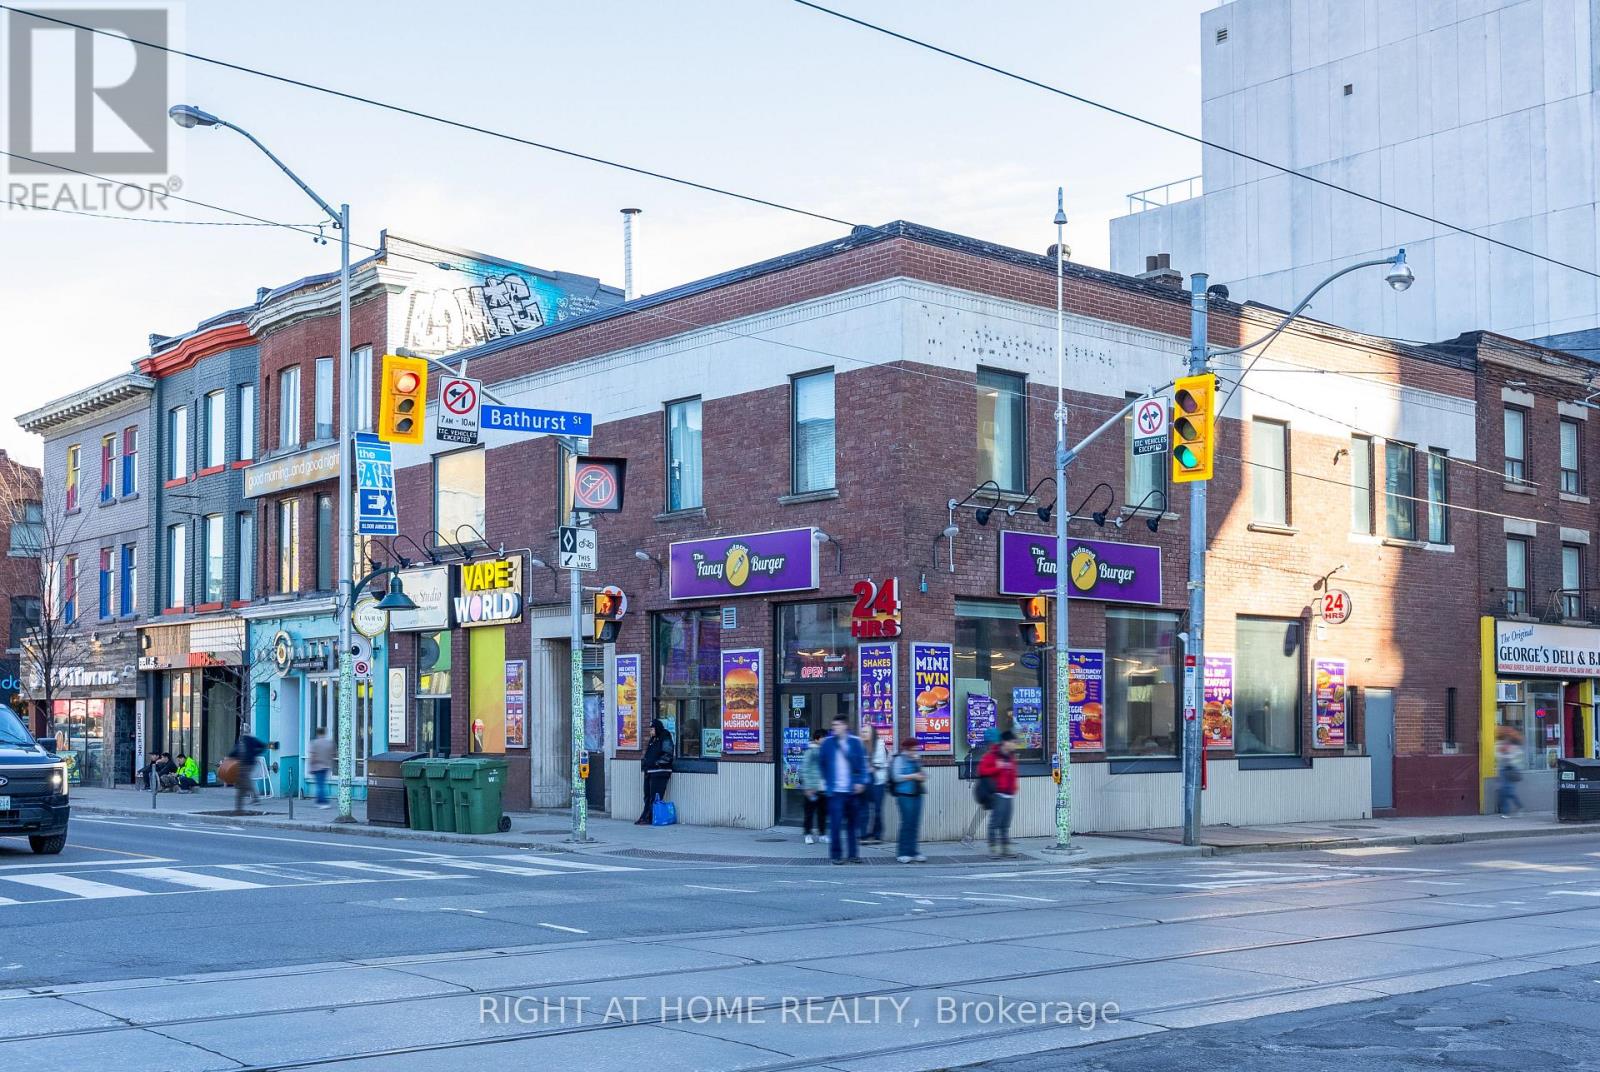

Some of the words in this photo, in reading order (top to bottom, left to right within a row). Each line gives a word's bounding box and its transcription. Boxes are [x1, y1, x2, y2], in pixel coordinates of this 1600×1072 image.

[441, 415, 454, 425] 7AM
[461, 418, 476, 427] 10AM
[491, 409, 566, 431] Bathurst
[573, 415, 582, 425] St
[443, 434, 470, 442] EXCEPTED
[450, 429, 477, 438] VEHICLES
[1144, 436, 1167, 446] VEHICLES
[359, 449, 376, 459] the
[1138, 444, 1162, 453] EXCEPTED
[305, 455, 324, 475] good
[1031, 547, 1045, 555] The
[697, 561, 724, 578] Fancy
[750, 555, 785, 574] Burger
[1036, 557, 1058, 574] Fan
[1098, 563, 1135, 584] Burger
[463, 561, 512, 591] VAPE
[853, 577, 898, 617] 24
[1325, 594, 1344, 612] 24
[454, 592, 519, 623] WORLD
[1325, 612, 1345, 620] HRS
[851, 619, 900, 638] HRS
[1500, 633, 1511, 644] The
[1511, 625, 1534, 642] Original
[1499, 645, 1550, 664] GEORGE'S
[1552, 649, 1574, 665] DELI
[1577, 651, 1586, 665] &
[1588, 651, 1600, 666] B.
[863, 659, 891, 668] SHAKES
[915, 657, 949, 671] MINI
[801, 666, 824, 679] OPEN
[915, 672, 949, 685] TWIN
[724, 720, 760, 728] MUSHROOM
[789, 729, 805, 738] TFIB
